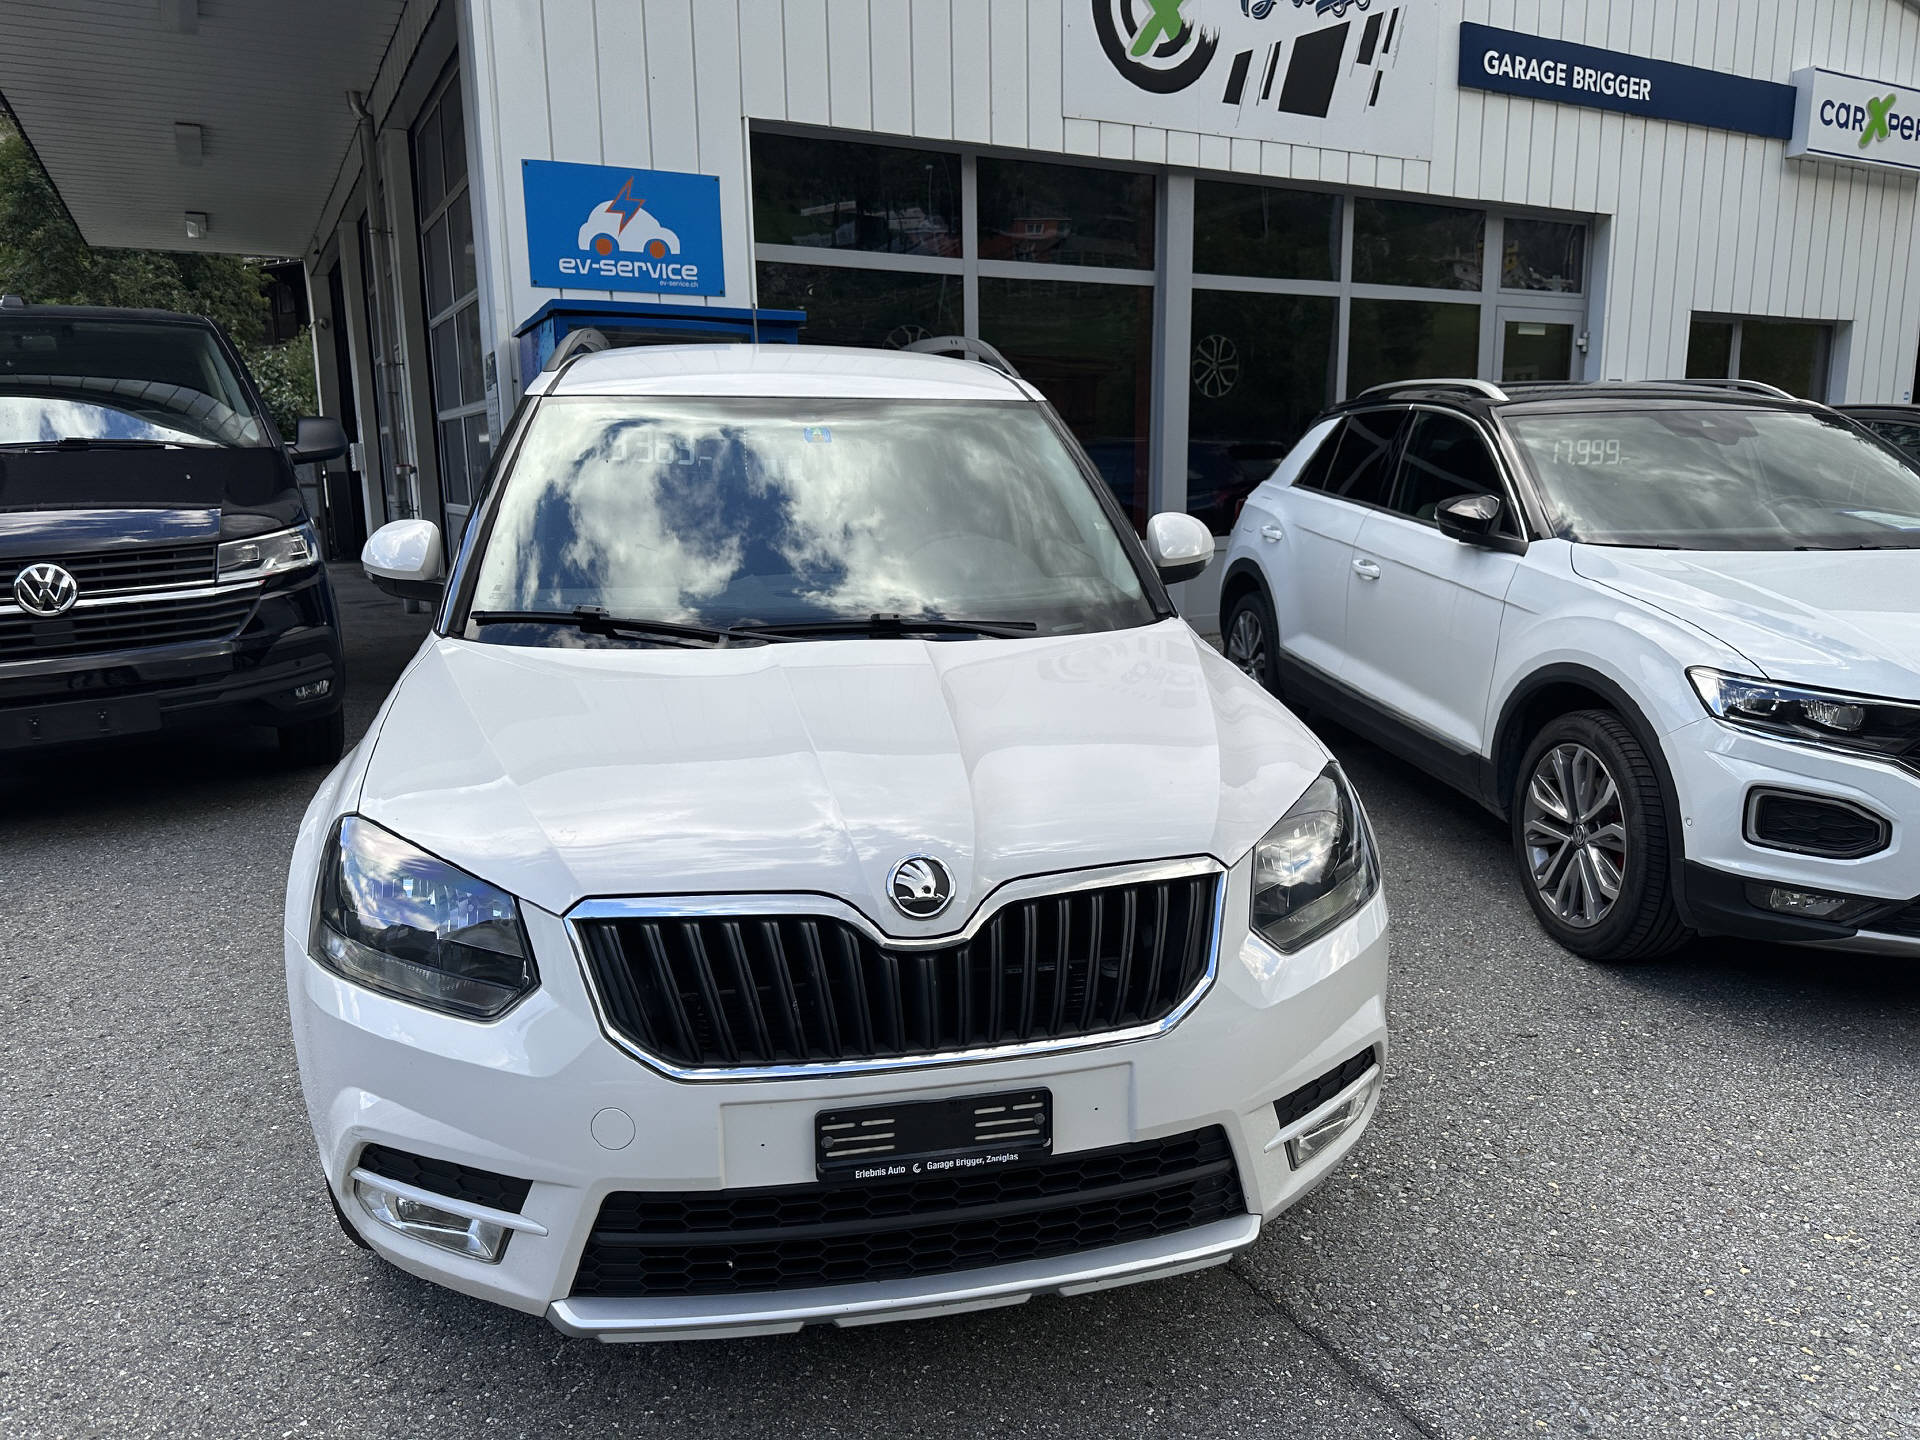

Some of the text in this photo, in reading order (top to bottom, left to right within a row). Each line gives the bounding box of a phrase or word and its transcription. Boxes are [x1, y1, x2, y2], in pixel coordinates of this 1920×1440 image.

[1484, 50, 1652, 101] GARAGE BRIGGER
[558, 257, 698, 280] ev-service
[855, 1168, 887, 1179] Erlebnis
[887, 1164, 906, 1177] Auto
[927, 1160, 955, 1171] Garage
